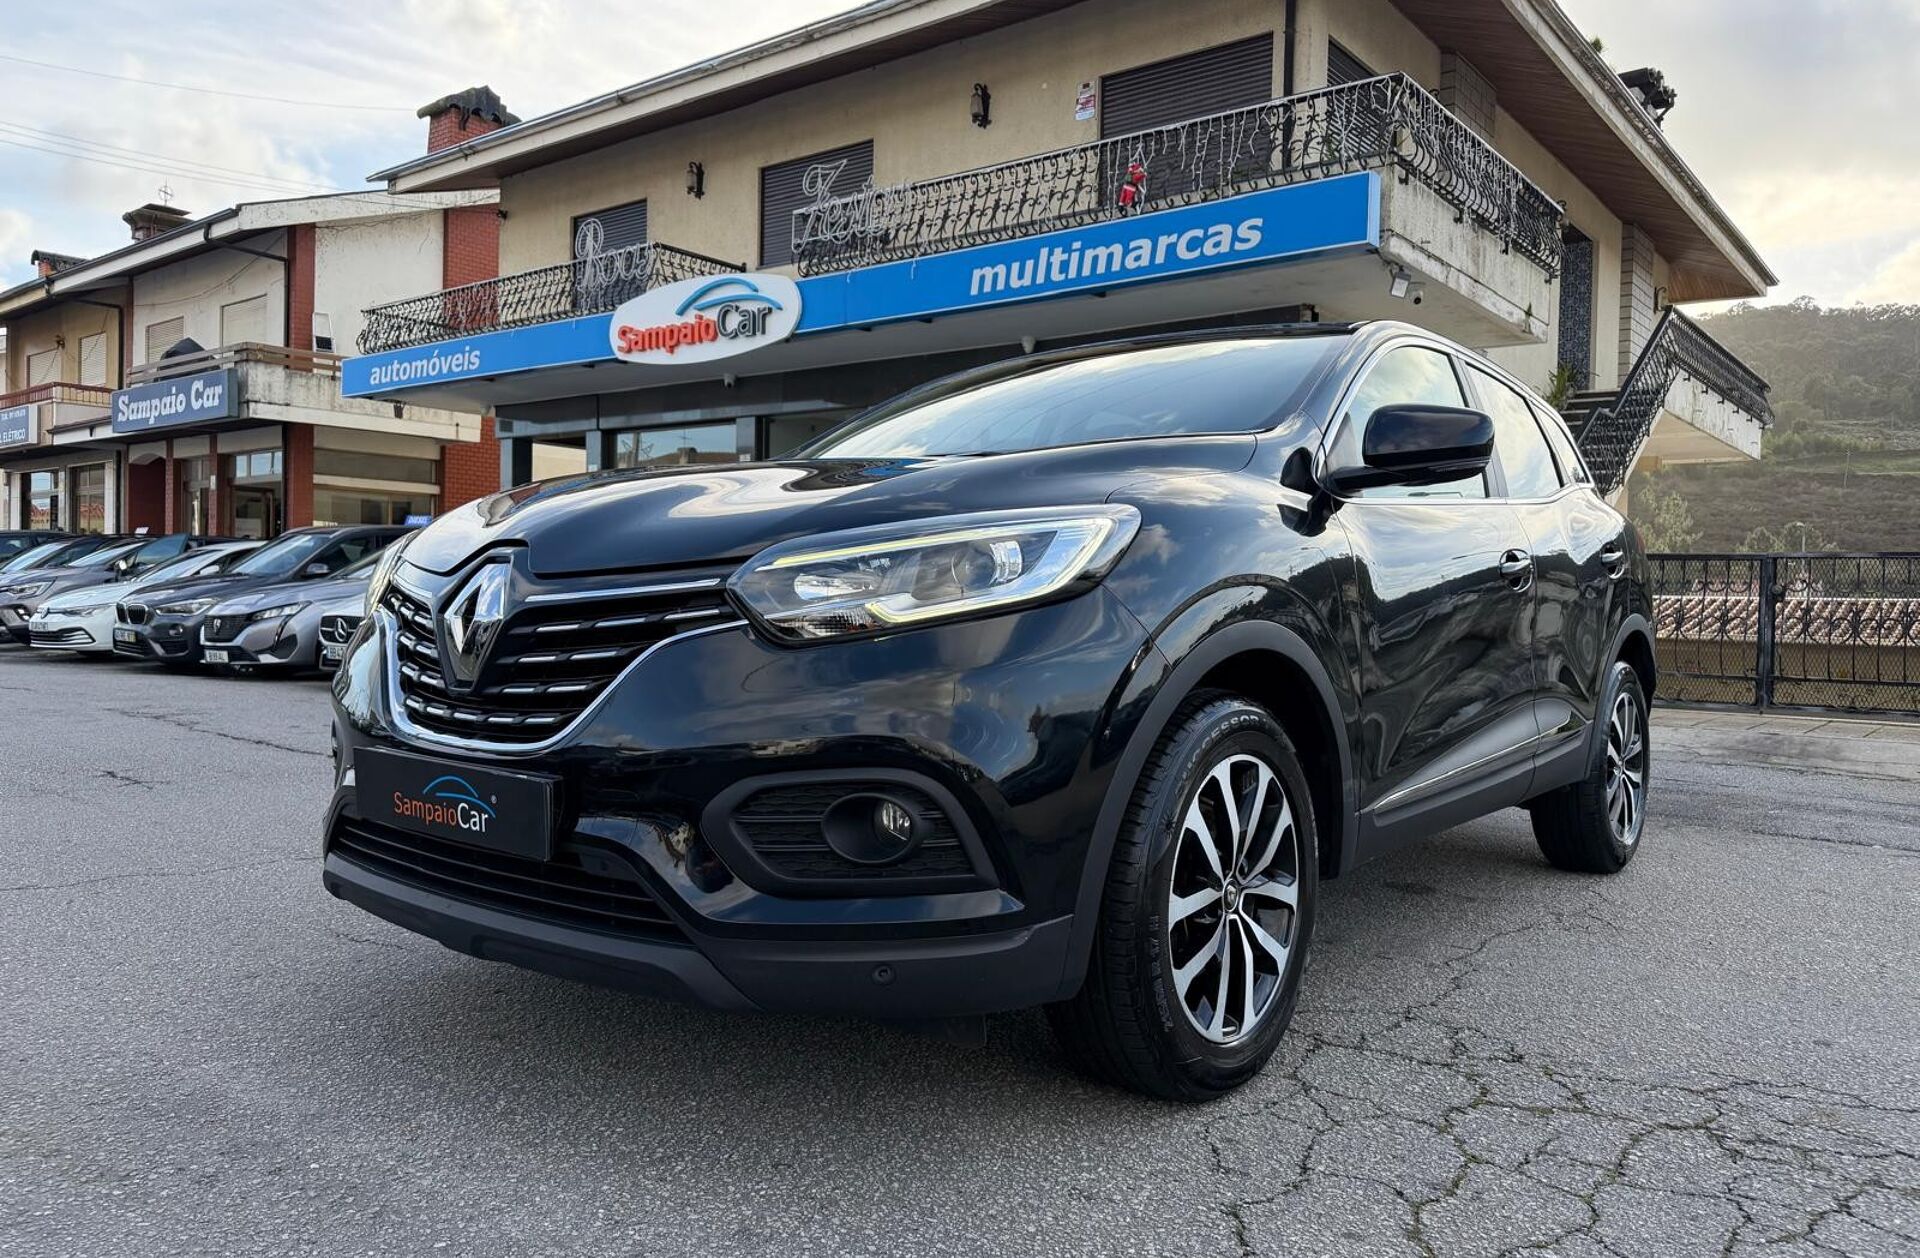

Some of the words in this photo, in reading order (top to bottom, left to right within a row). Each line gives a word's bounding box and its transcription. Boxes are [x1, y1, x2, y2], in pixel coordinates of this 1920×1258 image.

[970, 217, 1263, 296] multimarcas
[617, 303, 773, 355] SampaioCar
[370, 345, 481, 385] automóveis
[117, 386, 186, 424] Sampaio
[190, 379, 222, 410] Car
[394, 791, 489, 833] SampaioCar
